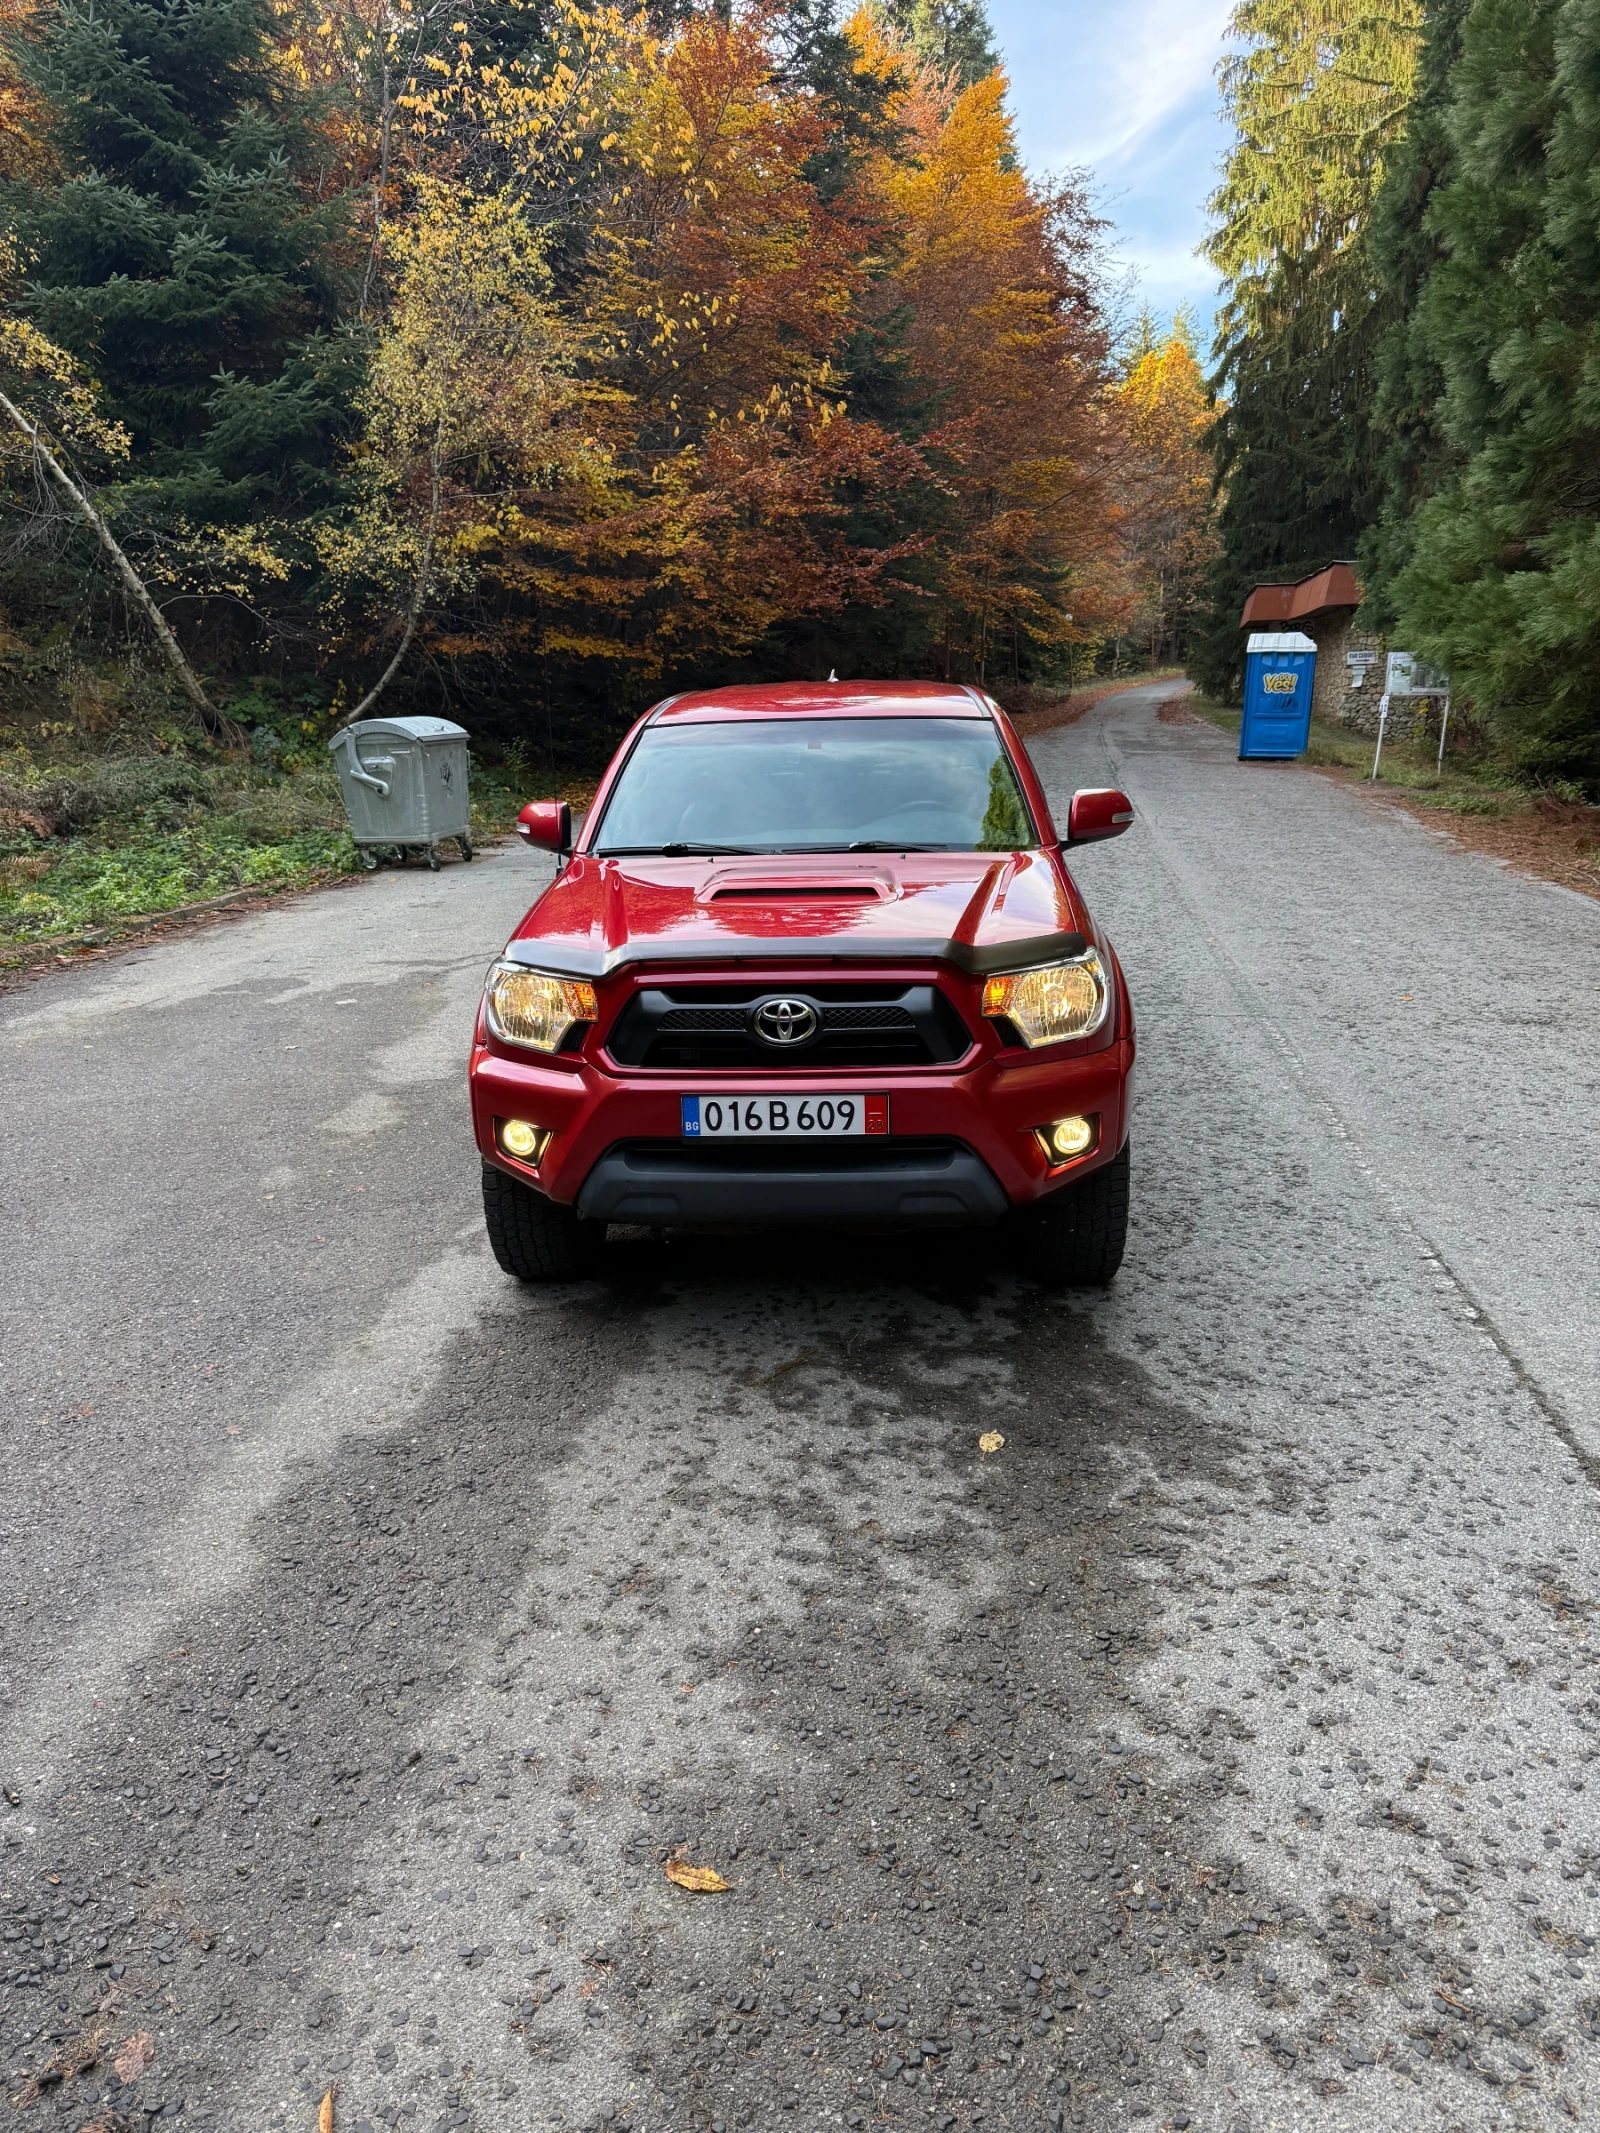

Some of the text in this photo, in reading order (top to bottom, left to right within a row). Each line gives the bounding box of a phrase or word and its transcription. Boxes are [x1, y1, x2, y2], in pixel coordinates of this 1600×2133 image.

[1264, 673, 1298, 692] Yes!
[685, 1121, 699, 1131] BG
[704, 1100, 855, 1131] 016B609
